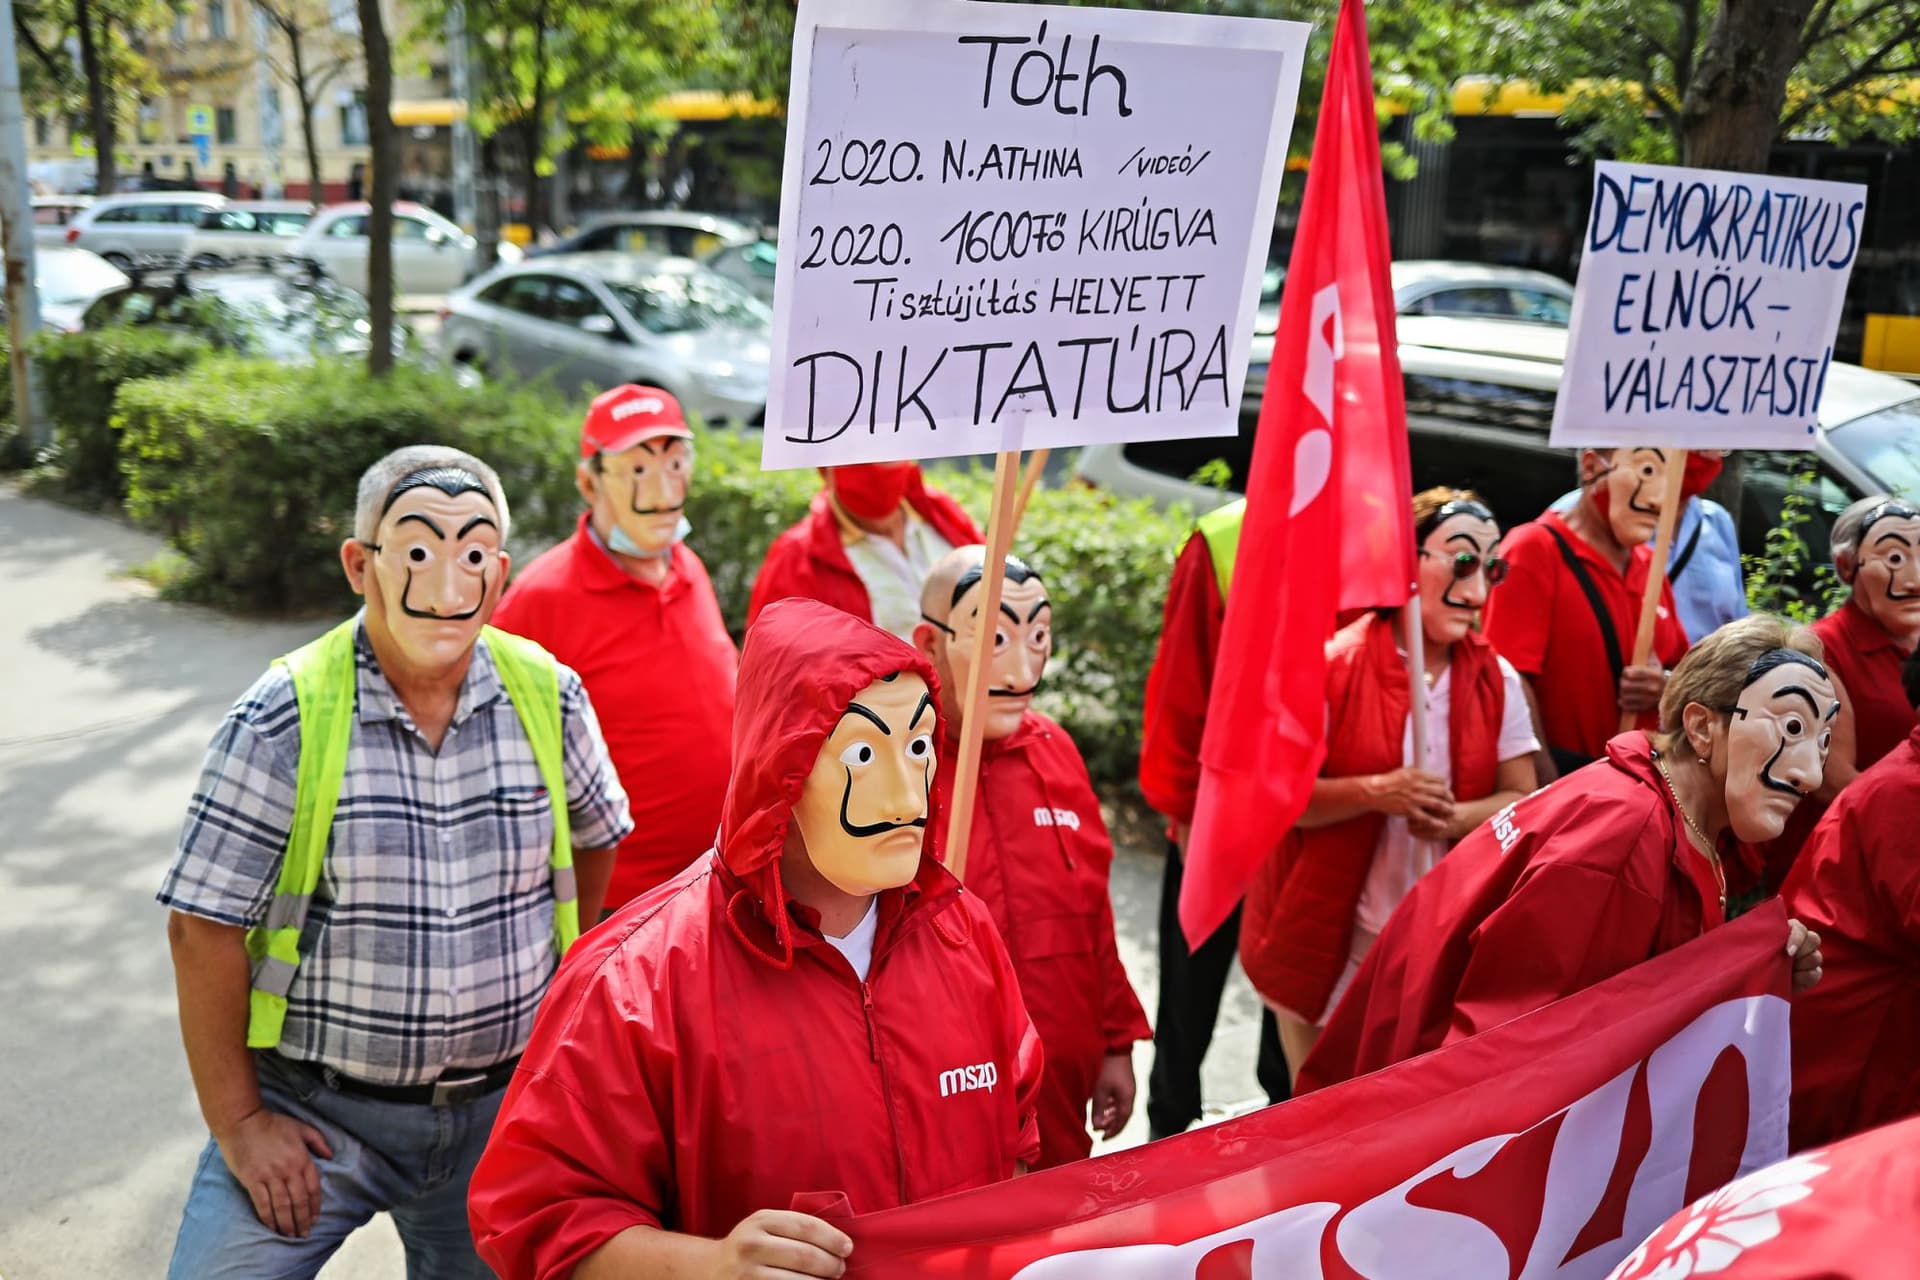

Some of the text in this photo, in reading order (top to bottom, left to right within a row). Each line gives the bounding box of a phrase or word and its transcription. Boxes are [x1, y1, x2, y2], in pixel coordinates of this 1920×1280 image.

[958, 20, 1132, 117] Tóth
[809, 138, 1211, 186] 2020. N.ATHINA /VIDEÓ/
[800, 223, 912, 269] 2020.
[1077, 196, 1217, 255] KIRÚGVA
[1589, 172, 1864, 272] DEMOKRATIKUS
[853, 274, 1205, 322] Tisztújítás HELYETT
[785, 324, 1230, 443] DIKTATÚRA
[1604, 331, 1832, 435] VÁLASZTÁST!
[939, 1061, 998, 1097] mszp
